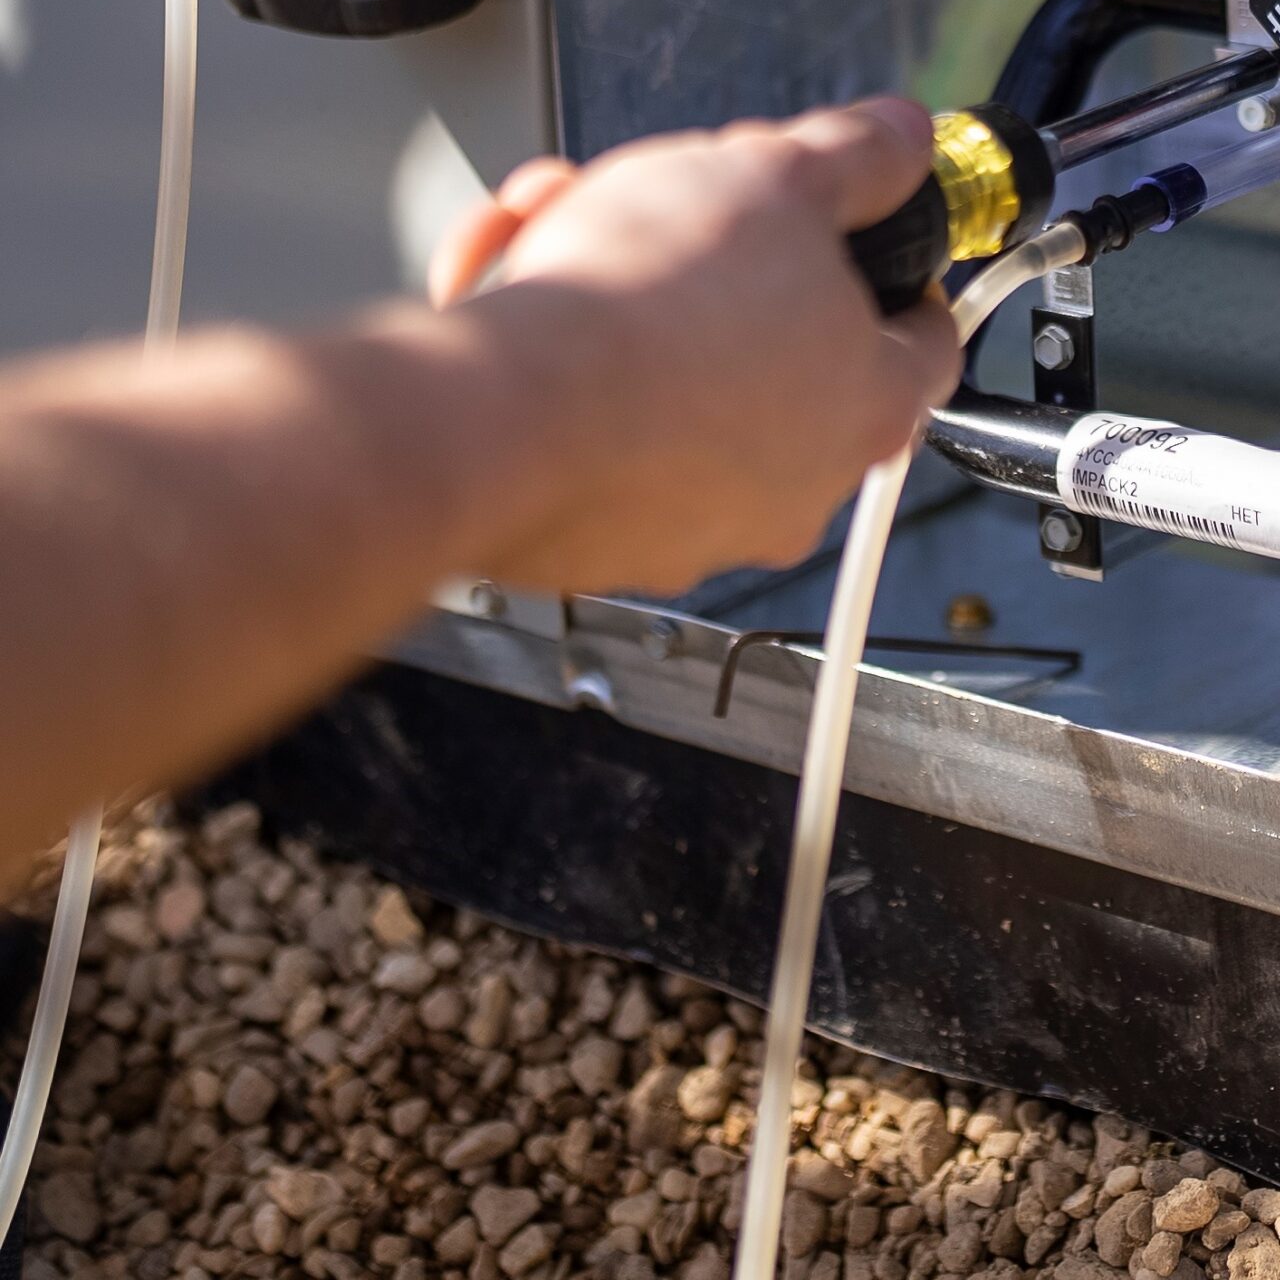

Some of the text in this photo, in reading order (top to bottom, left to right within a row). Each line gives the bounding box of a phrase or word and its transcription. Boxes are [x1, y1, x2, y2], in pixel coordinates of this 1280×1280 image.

[1090, 420, 1188, 454] 700092
[1072, 468, 1138, 498] IMPACK2
[1231, 505, 1262, 526] HET
